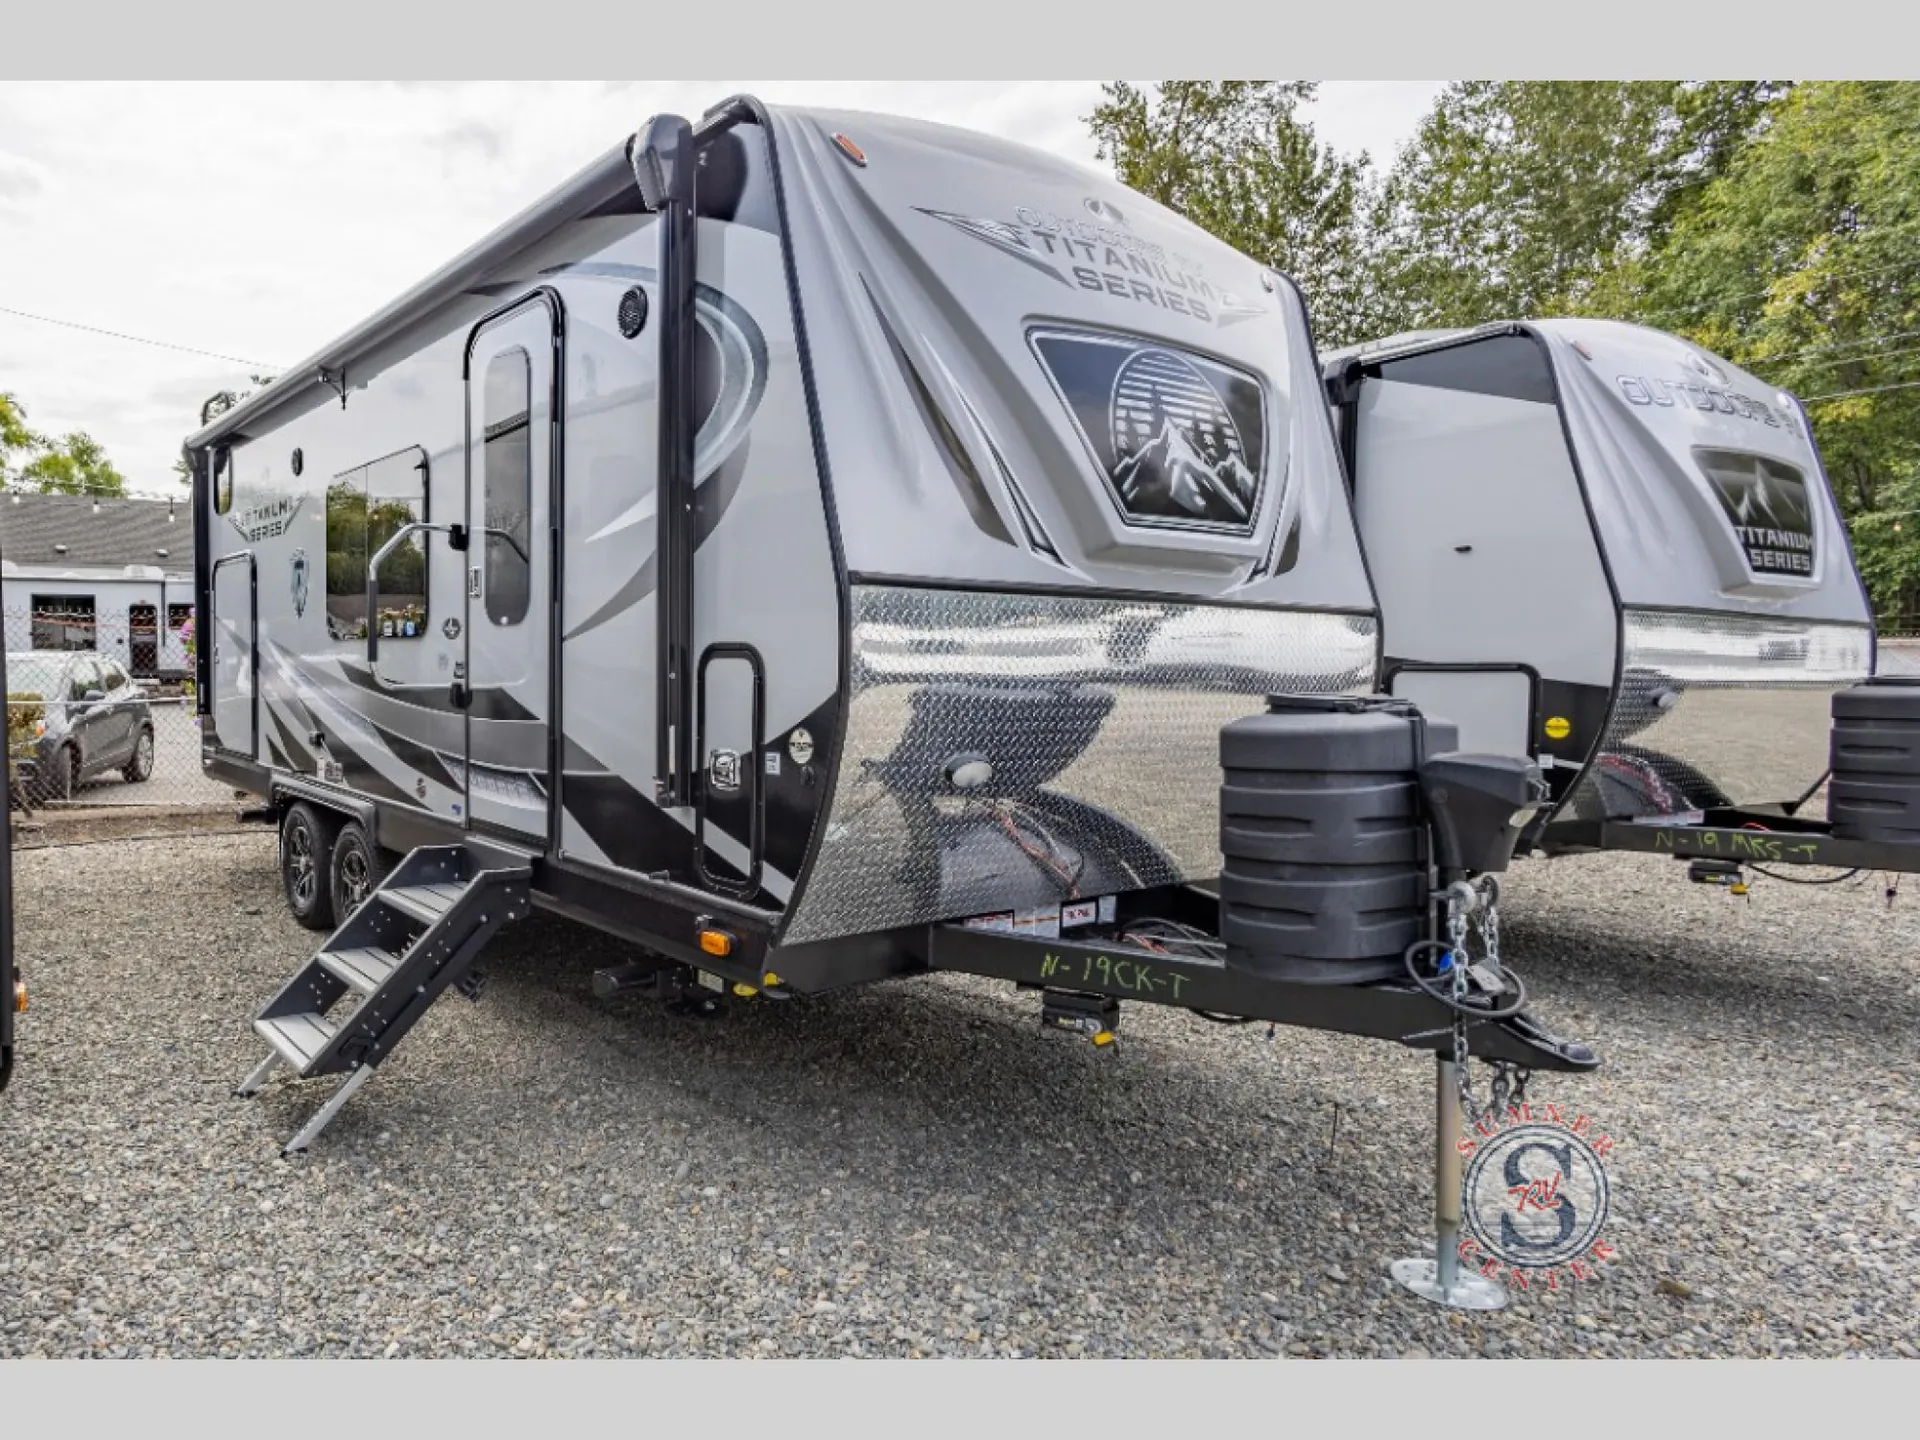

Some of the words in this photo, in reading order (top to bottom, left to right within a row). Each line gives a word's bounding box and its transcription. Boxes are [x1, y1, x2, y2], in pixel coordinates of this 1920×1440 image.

[1032, 229, 1217, 301] TITANIUM
[1072, 266, 1213, 323] SERIES
[1735, 526, 1812, 548] TITANIUM
[1751, 552, 1812, 571] SERIES
